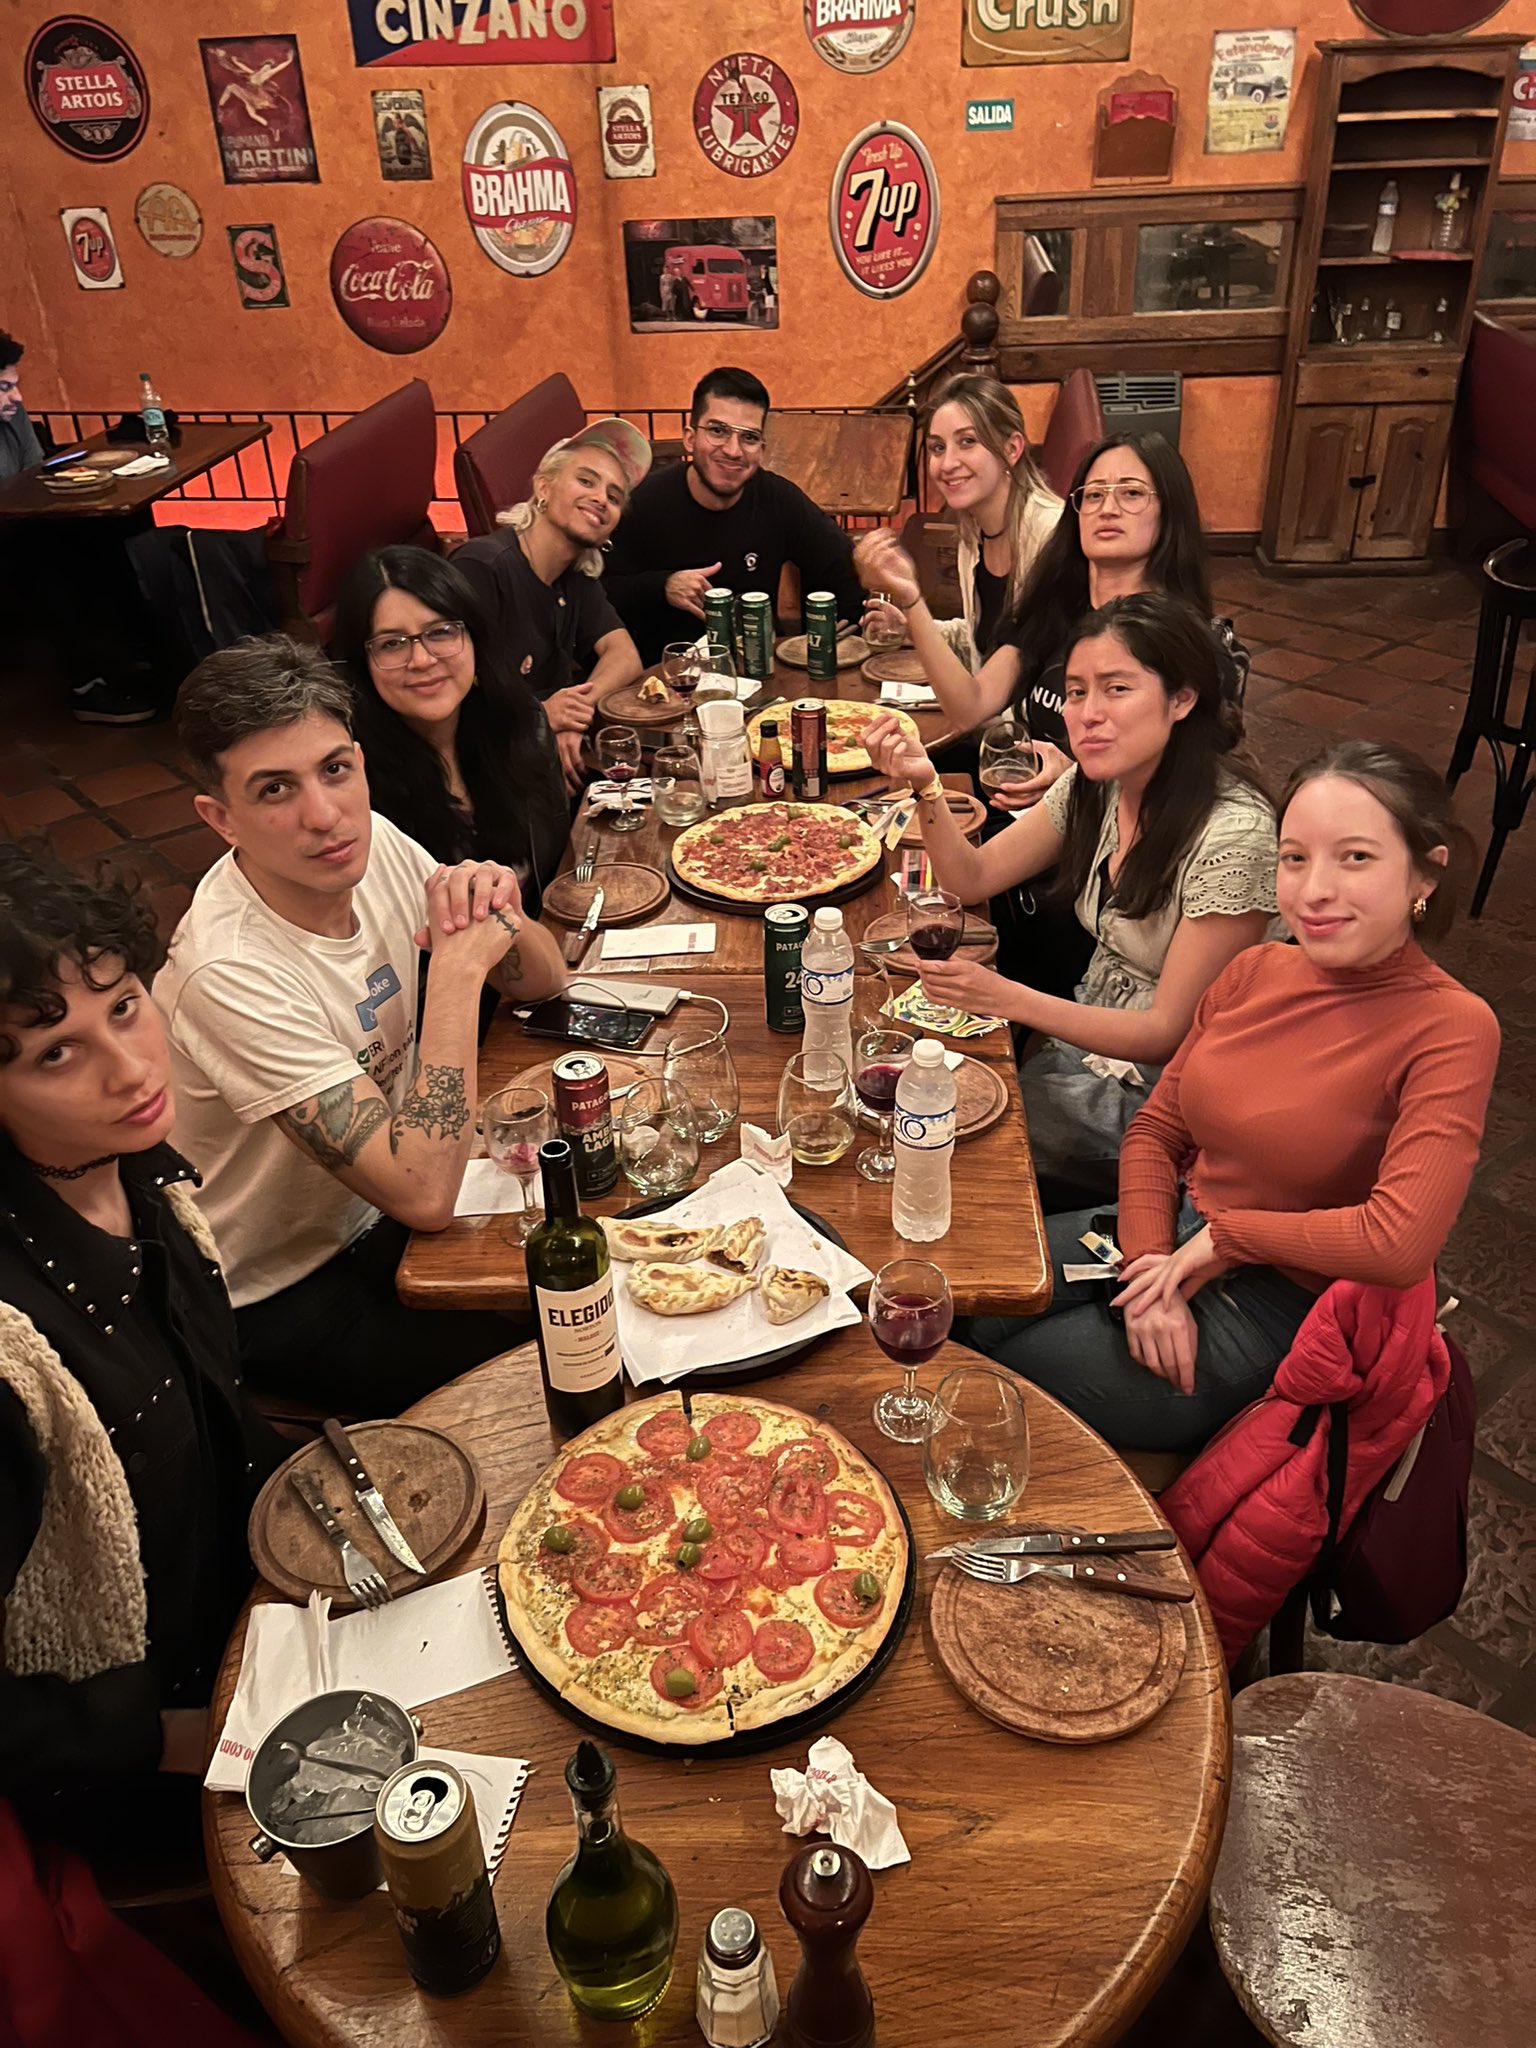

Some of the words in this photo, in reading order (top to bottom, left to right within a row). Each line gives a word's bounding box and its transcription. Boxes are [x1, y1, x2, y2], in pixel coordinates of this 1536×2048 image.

[375, 0, 586, 44] CINZANO
[816, 0, 902, 27] BRAHMA
[977, 0, 1118, 31] Crush
[55, 74, 118, 91] STELLA
[61, 91, 123, 109] ARTOIS
[968, 105, 1013, 124] SALIDA
[223, 147, 315, 167] MARTINI
[698, 124, 795, 175] LUBRICANTES
[470, 169, 572, 217] BRAHMA
[547, 1286, 614, 1327] ELEGIDO
